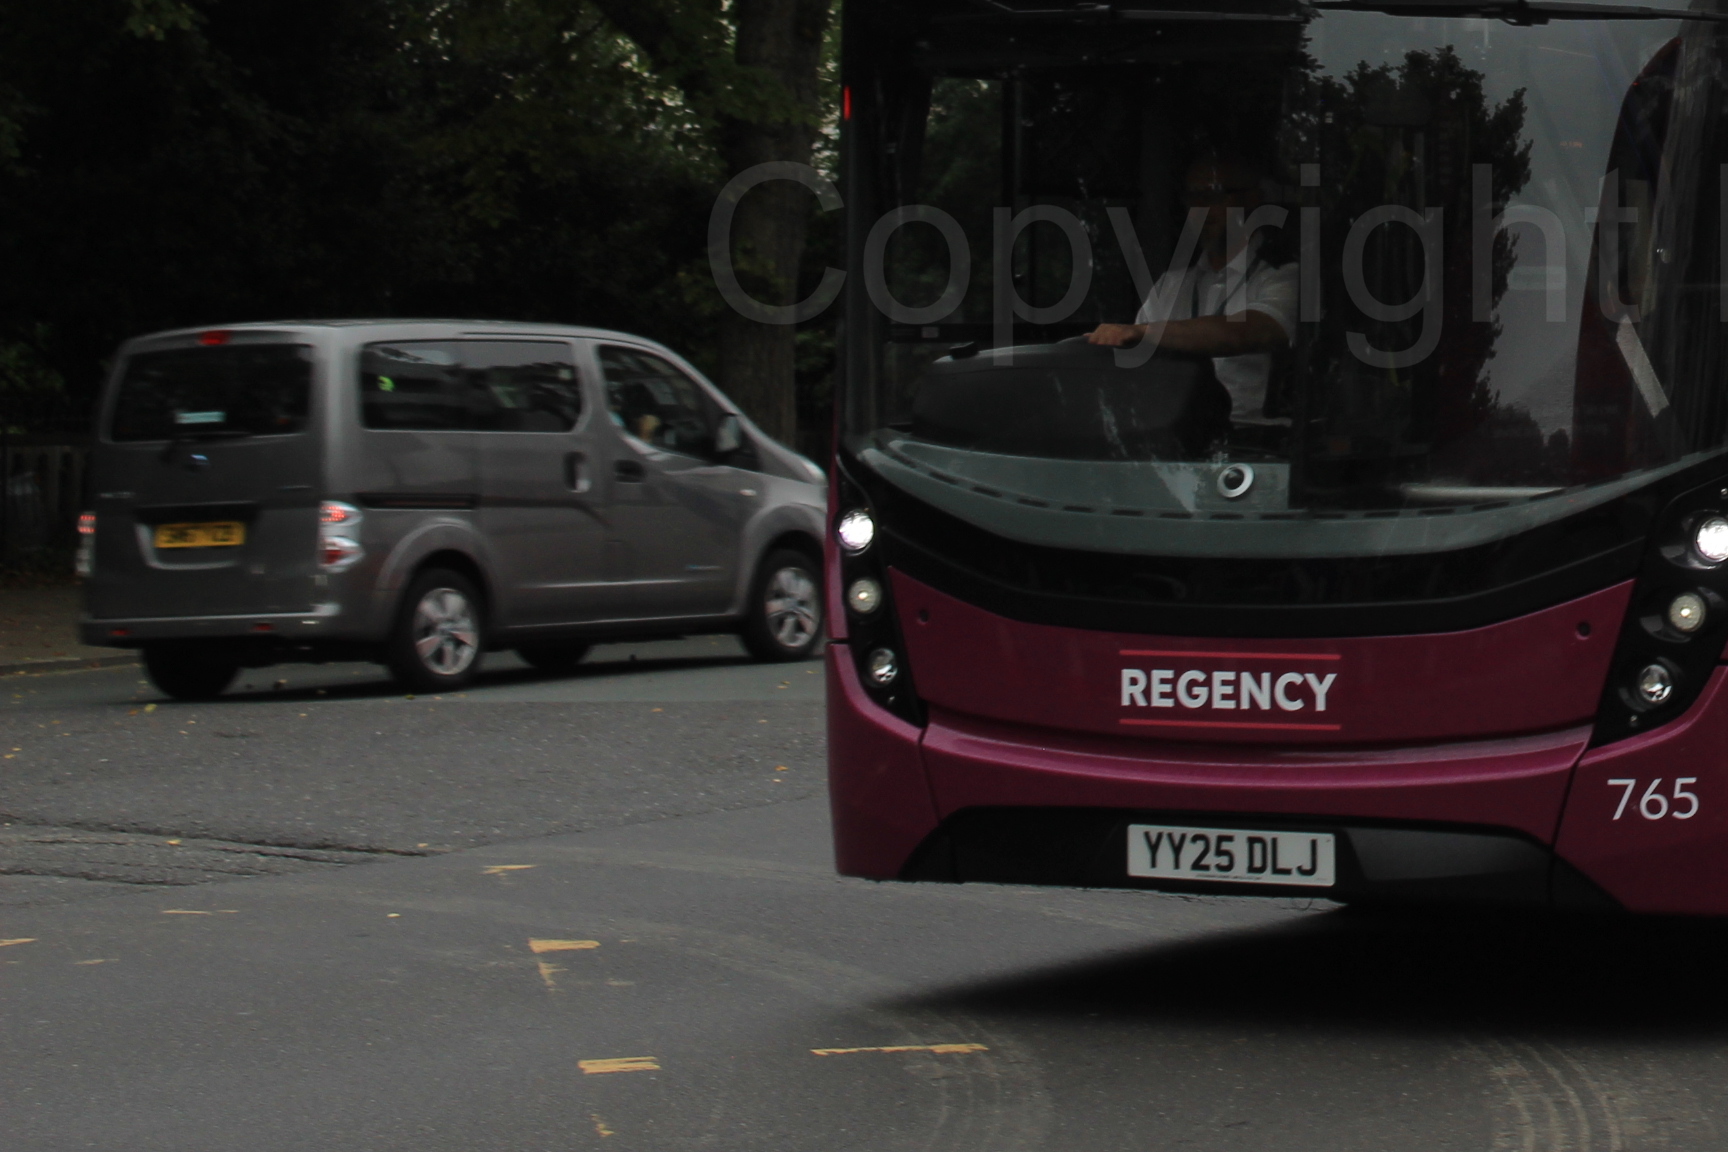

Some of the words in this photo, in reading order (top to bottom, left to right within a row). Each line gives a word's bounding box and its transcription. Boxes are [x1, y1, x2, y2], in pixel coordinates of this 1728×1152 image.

[1120, 668, 1338, 712] REGENCY
[1607, 774, 1701, 821] 765
[1143, 830, 1235, 874] YY25
[1247, 835, 1318, 877] DLJ
